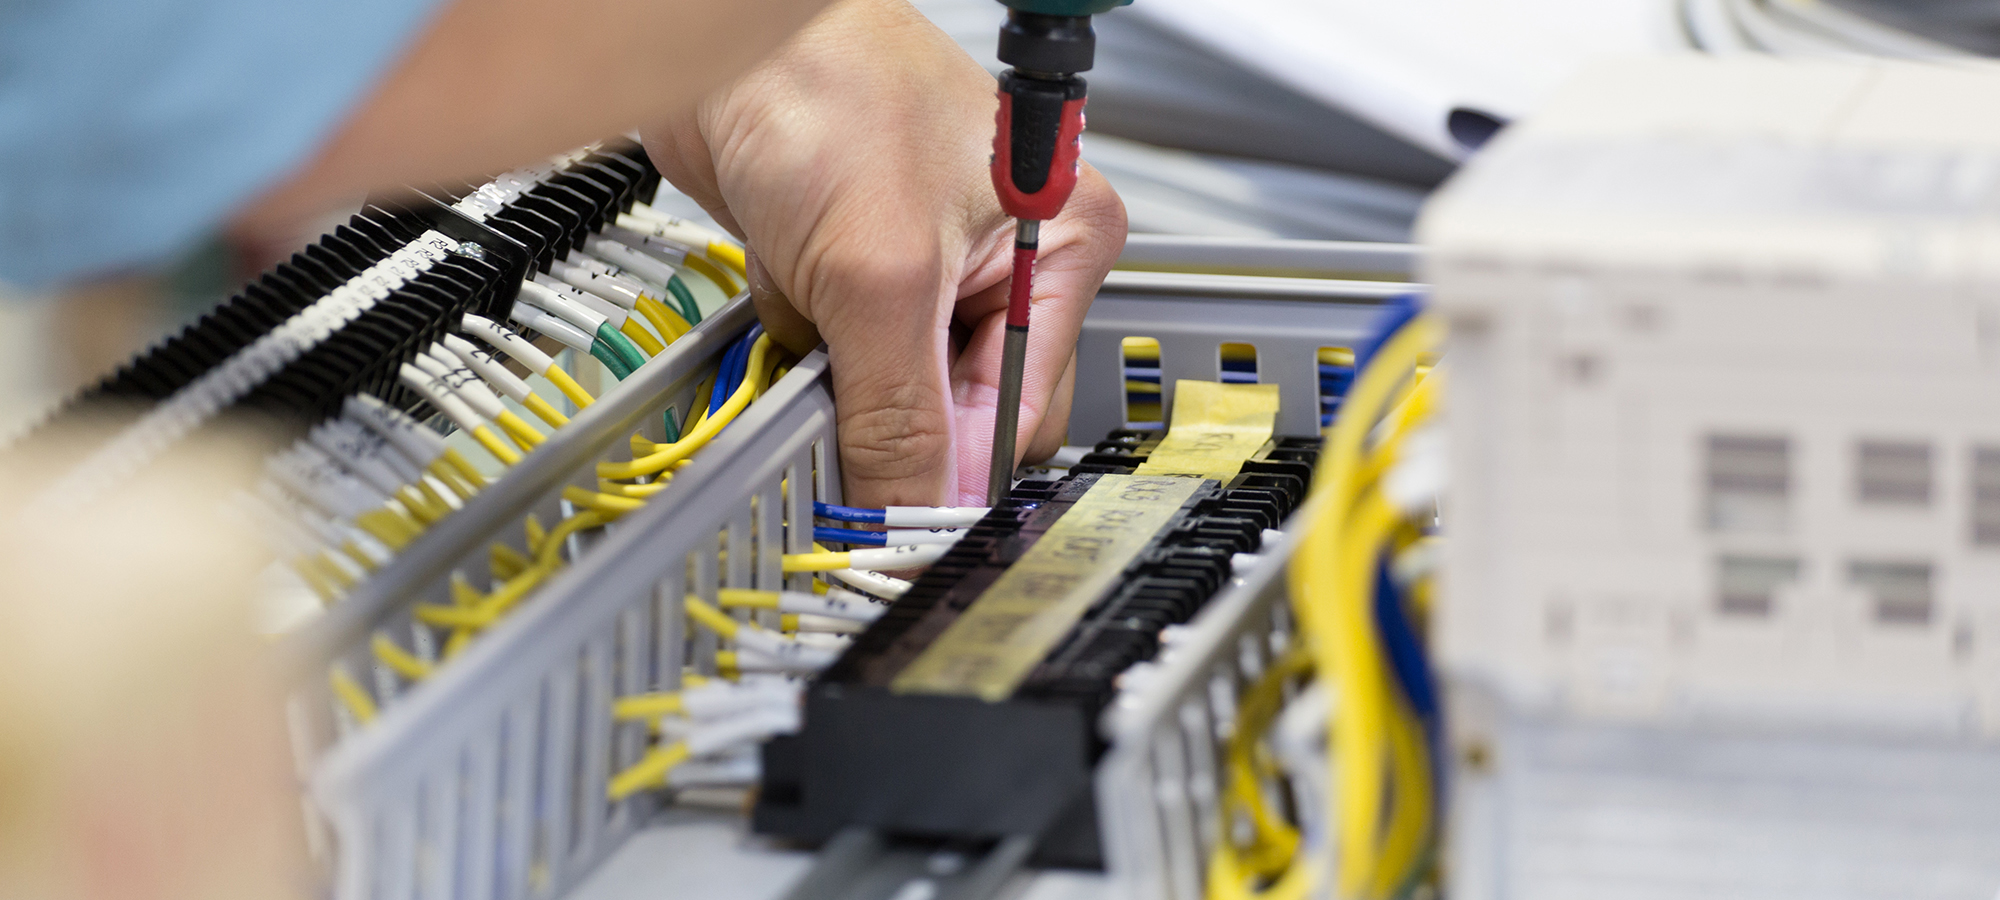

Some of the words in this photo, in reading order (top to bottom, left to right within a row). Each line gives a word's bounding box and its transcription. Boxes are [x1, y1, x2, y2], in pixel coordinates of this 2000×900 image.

[429, 238, 448, 250] R2
[415, 248, 434, 259] R2
[401, 257, 420, 268] R2
